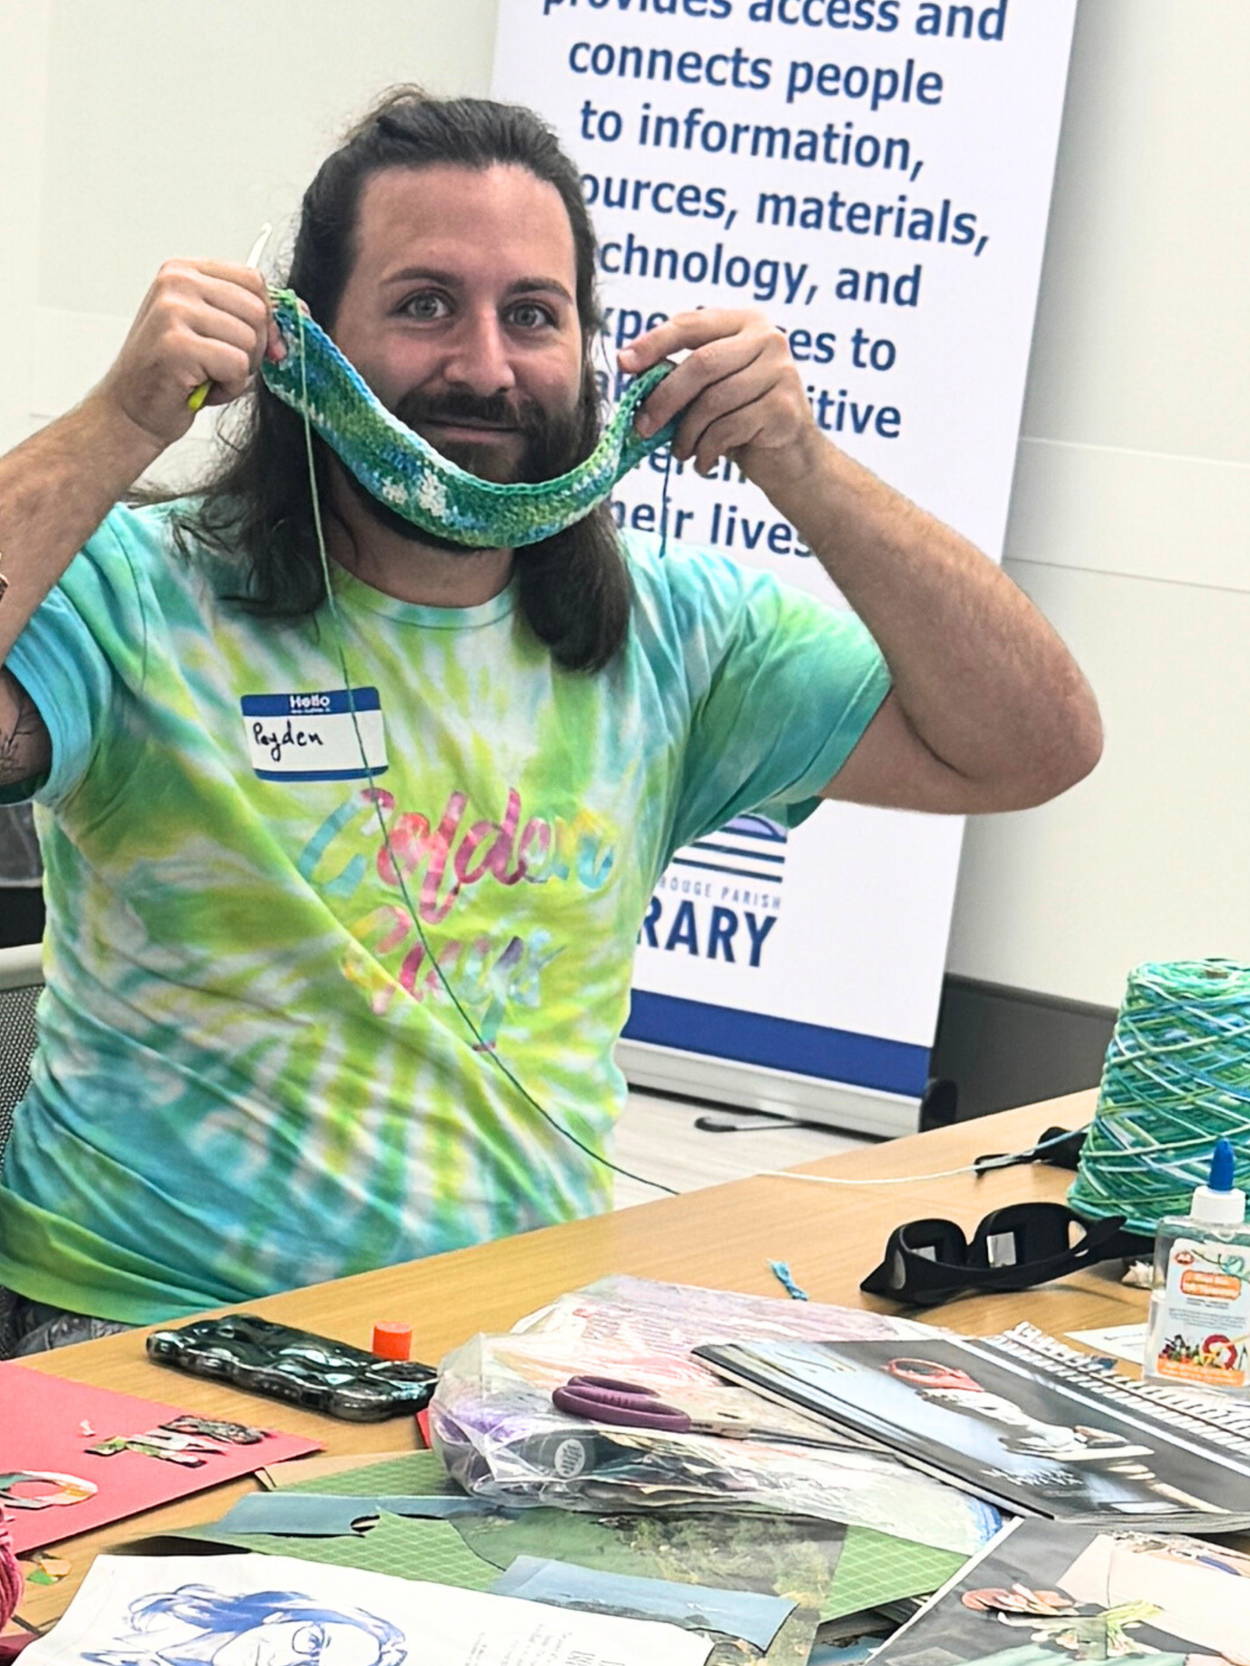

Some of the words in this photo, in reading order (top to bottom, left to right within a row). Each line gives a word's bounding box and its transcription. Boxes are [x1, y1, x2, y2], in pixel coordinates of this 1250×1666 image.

[748, 0, 900, 33] access
[915, 0, 1008, 41] and
[568, 42, 772, 90] connects
[786, 58, 943, 112] people
[580, 100, 623, 142] to
[639, 102, 924, 182] information,
[580, 173, 738, 231] ources,
[756, 192, 989, 257] materials,
[599, 232, 819, 306] chnology,
[835, 264, 922, 307] and
[851, 327, 896, 372] to
[806, 385, 901, 439] tive
[289, 694, 331, 709] Hello
[720, 886, 783, 910] PARISH
[636, 894, 778, 968] RARY
